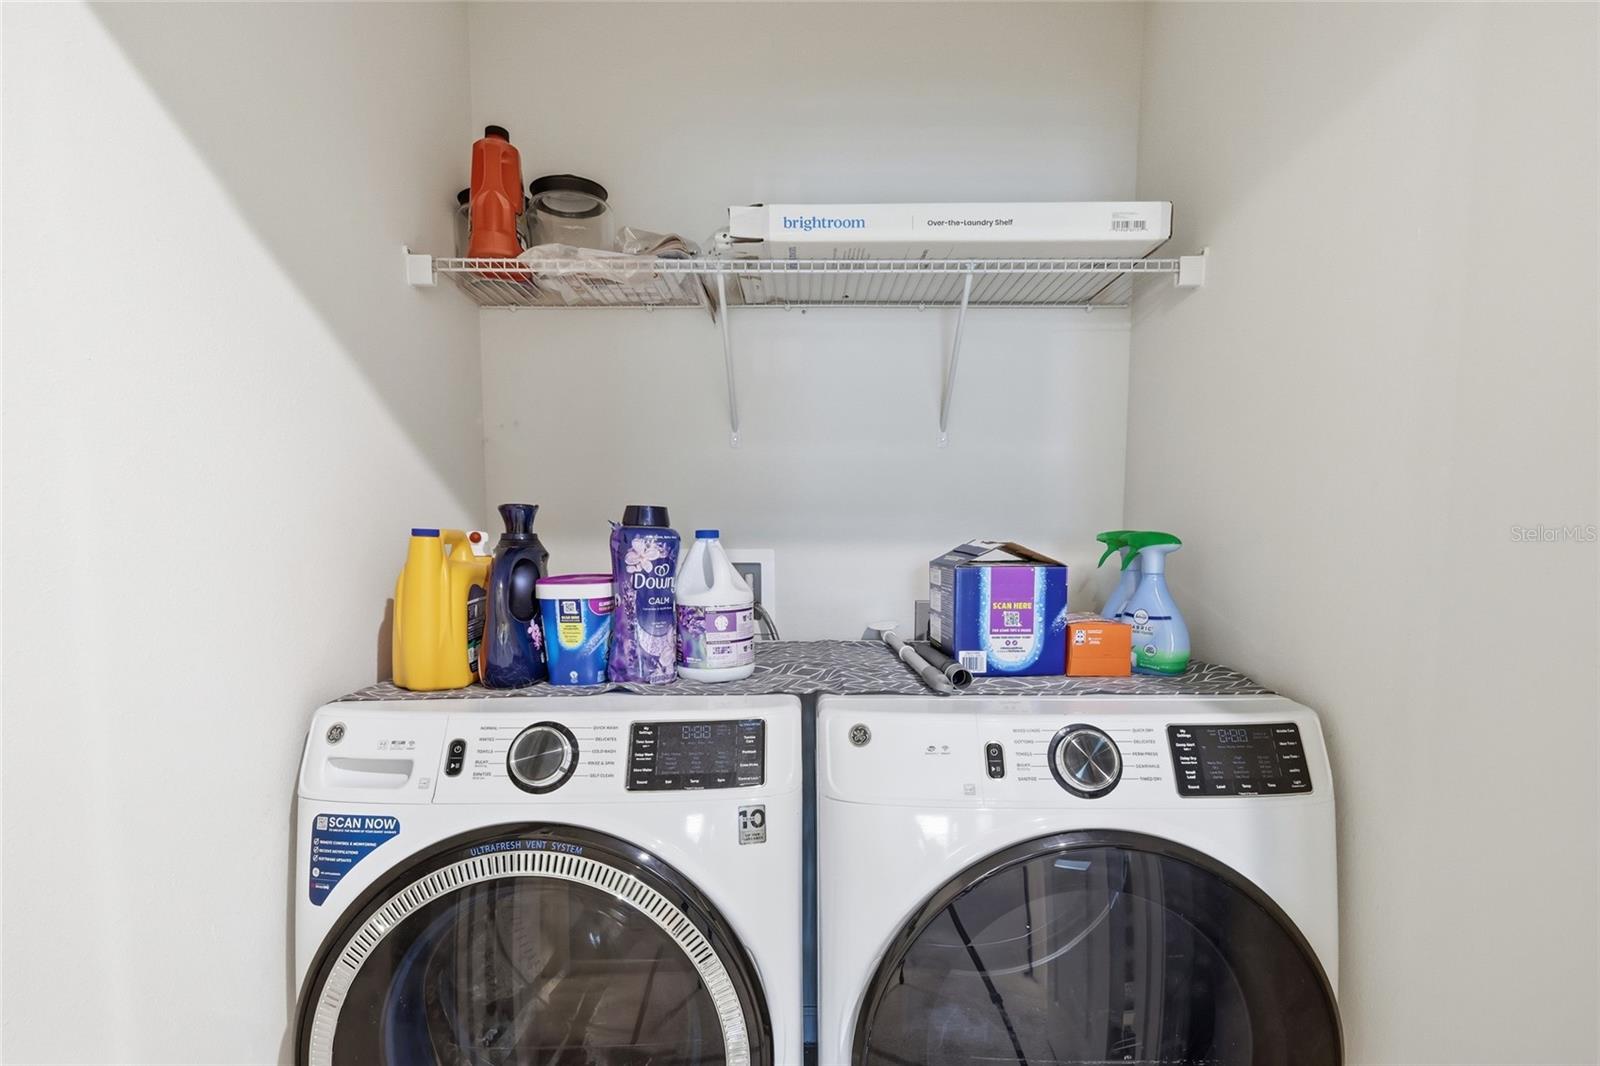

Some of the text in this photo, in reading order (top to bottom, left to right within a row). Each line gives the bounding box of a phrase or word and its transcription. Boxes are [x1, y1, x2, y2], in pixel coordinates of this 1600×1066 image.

[784, 216, 865, 232] brightroom
[927, 218, 1014, 228] Over-the-Laundry Shelf
[648, 597, 671, 605] CALM
[993, 602, 1033, 610] SCAN HERE
[329, 816, 397, 830] SCAN NOW
[739, 809, 765, 829] 10
[470, 840, 583, 856] ULTRAFRESH VENT SYSTEM
